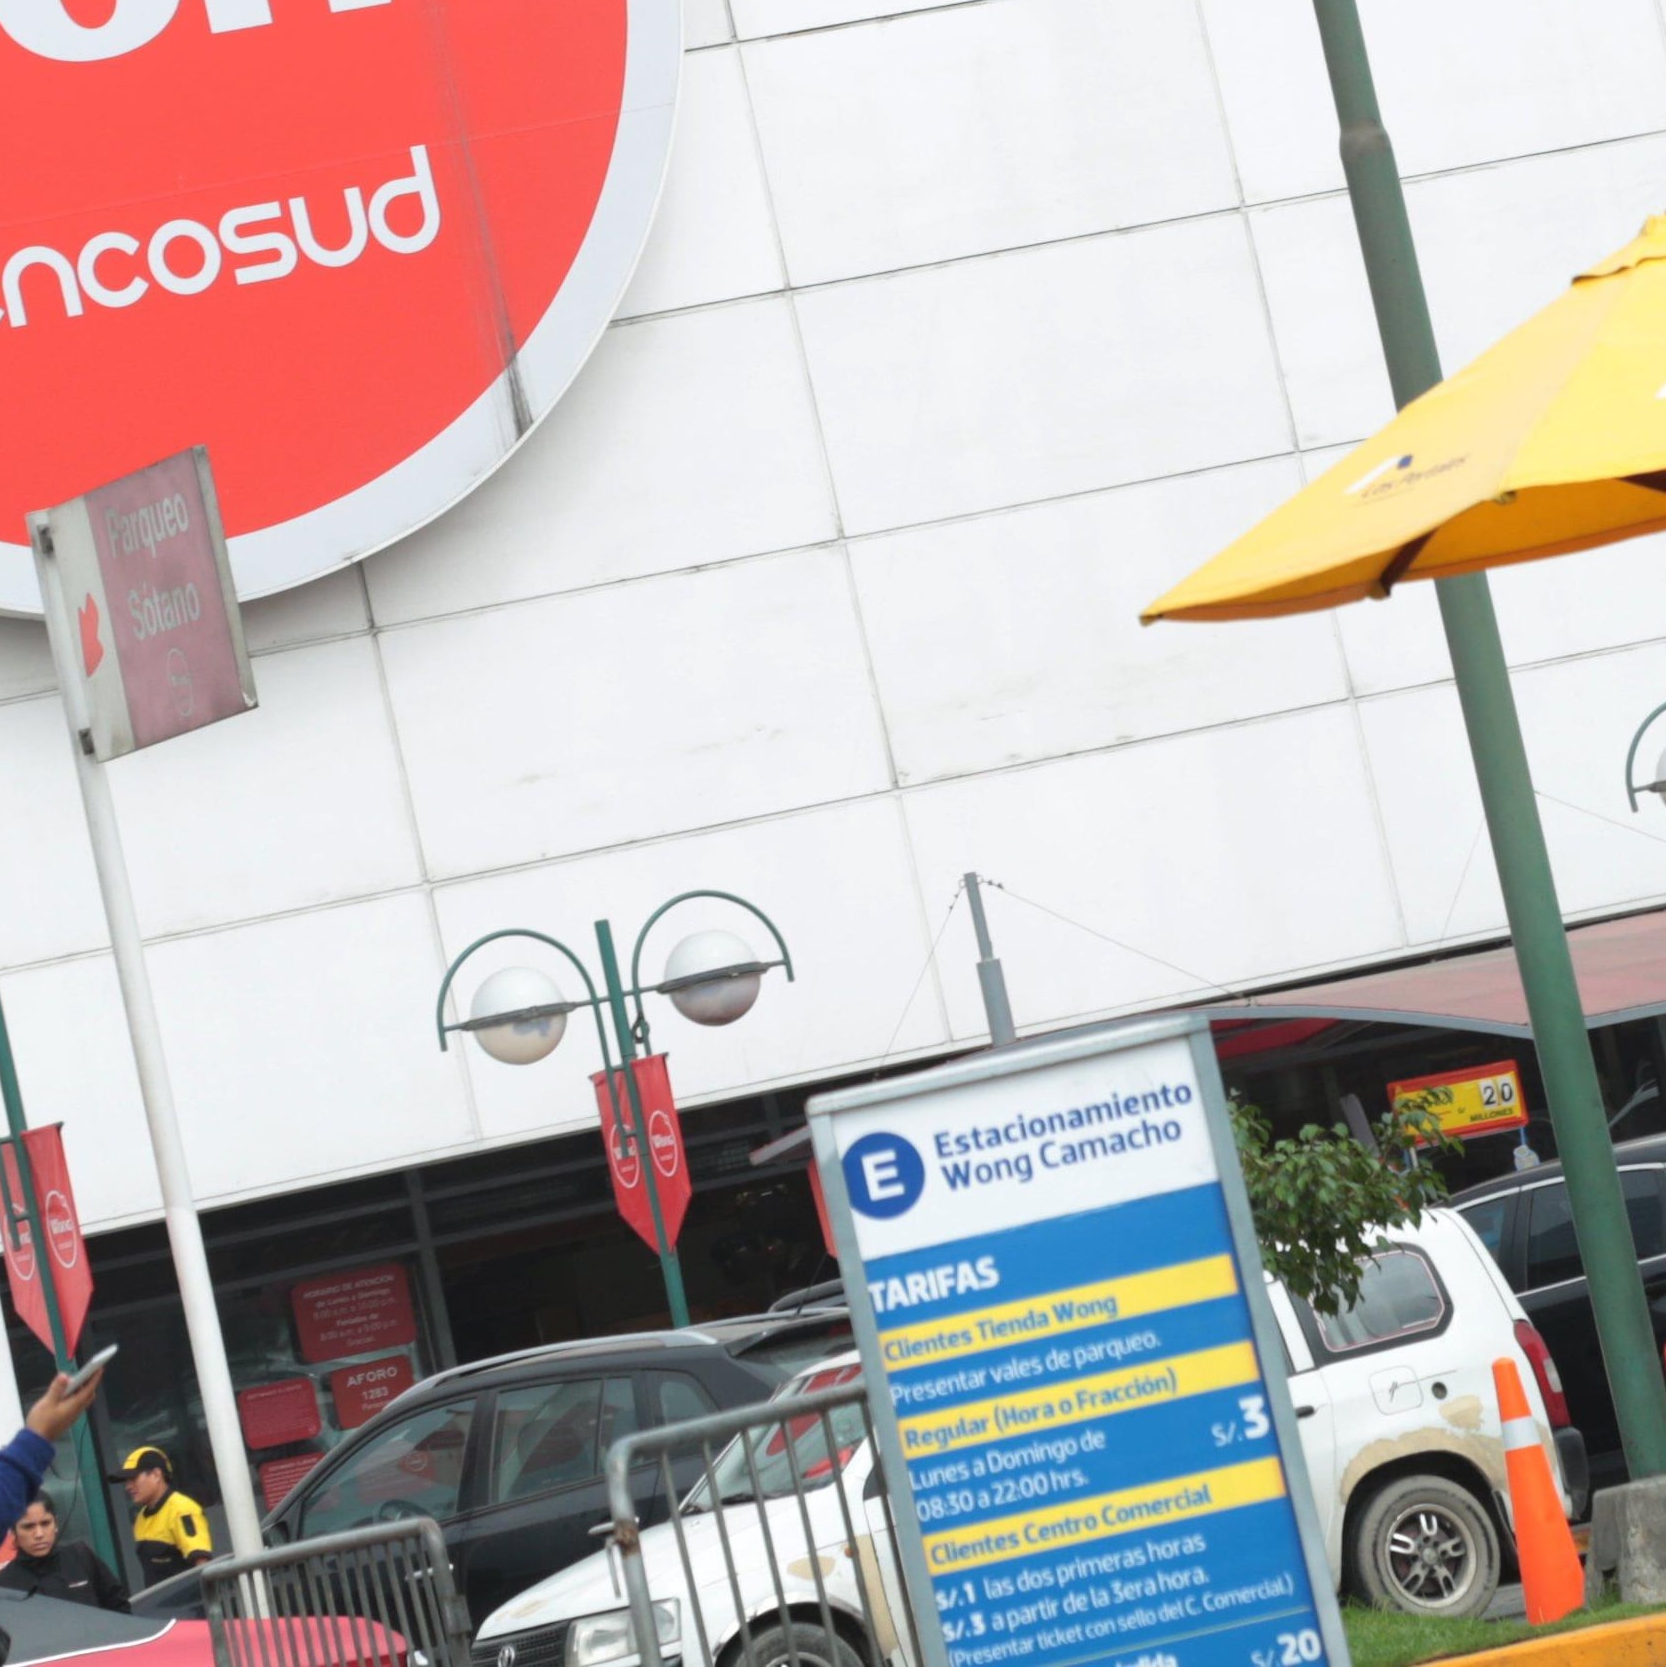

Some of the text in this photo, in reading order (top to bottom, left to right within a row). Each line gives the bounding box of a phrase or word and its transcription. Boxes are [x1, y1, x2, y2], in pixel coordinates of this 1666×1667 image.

[104, 492, 189, 558] Parqueo
[934, 1084, 1193, 1160] Estacionamiento
[1483, 1082, 1514, 1107] 20
[861, 1149, 906, 1202] E
[941, 1118, 1183, 1192] Wong Camacho
[867, 1255, 1001, 1313] TARIFAS
[884, 1295, 1119, 1362] Clientes Tienda Wong
[346, 1366, 398, 1388] AFORO
[889, 1330, 1162, 1407] Presentar vales de parqueo.
[904, 1366, 1179, 1450] Regular (Hora o Fracción)
[908, 1429, 1107, 1492] Lunes a Domingo de
[916, 1469, 1090, 1523] 08:30 a 22:00 hrs.
[930, 1483, 1213, 1567] Clientes Centro Comercial
[983, 1576, 1015, 1601] las
[1017, 1567, 1055, 1593] dos
[1056, 1547, 1147, 1589] primeras
[1146, 1533, 1207, 1563] horas
[991, 1613, 1005, 1632] a
[1005, 1596, 1061, 1633] partir
[1062, 1591, 1089, 1616] de
[1089, 1586, 1111, 1609] la
[1110, 1579, 1158, 1605] 3era
[1157, 1565, 1211, 1594] hora.
[948, 1571, 1295, 1667] (Presentar ticket con sello del C. Comercial.)
